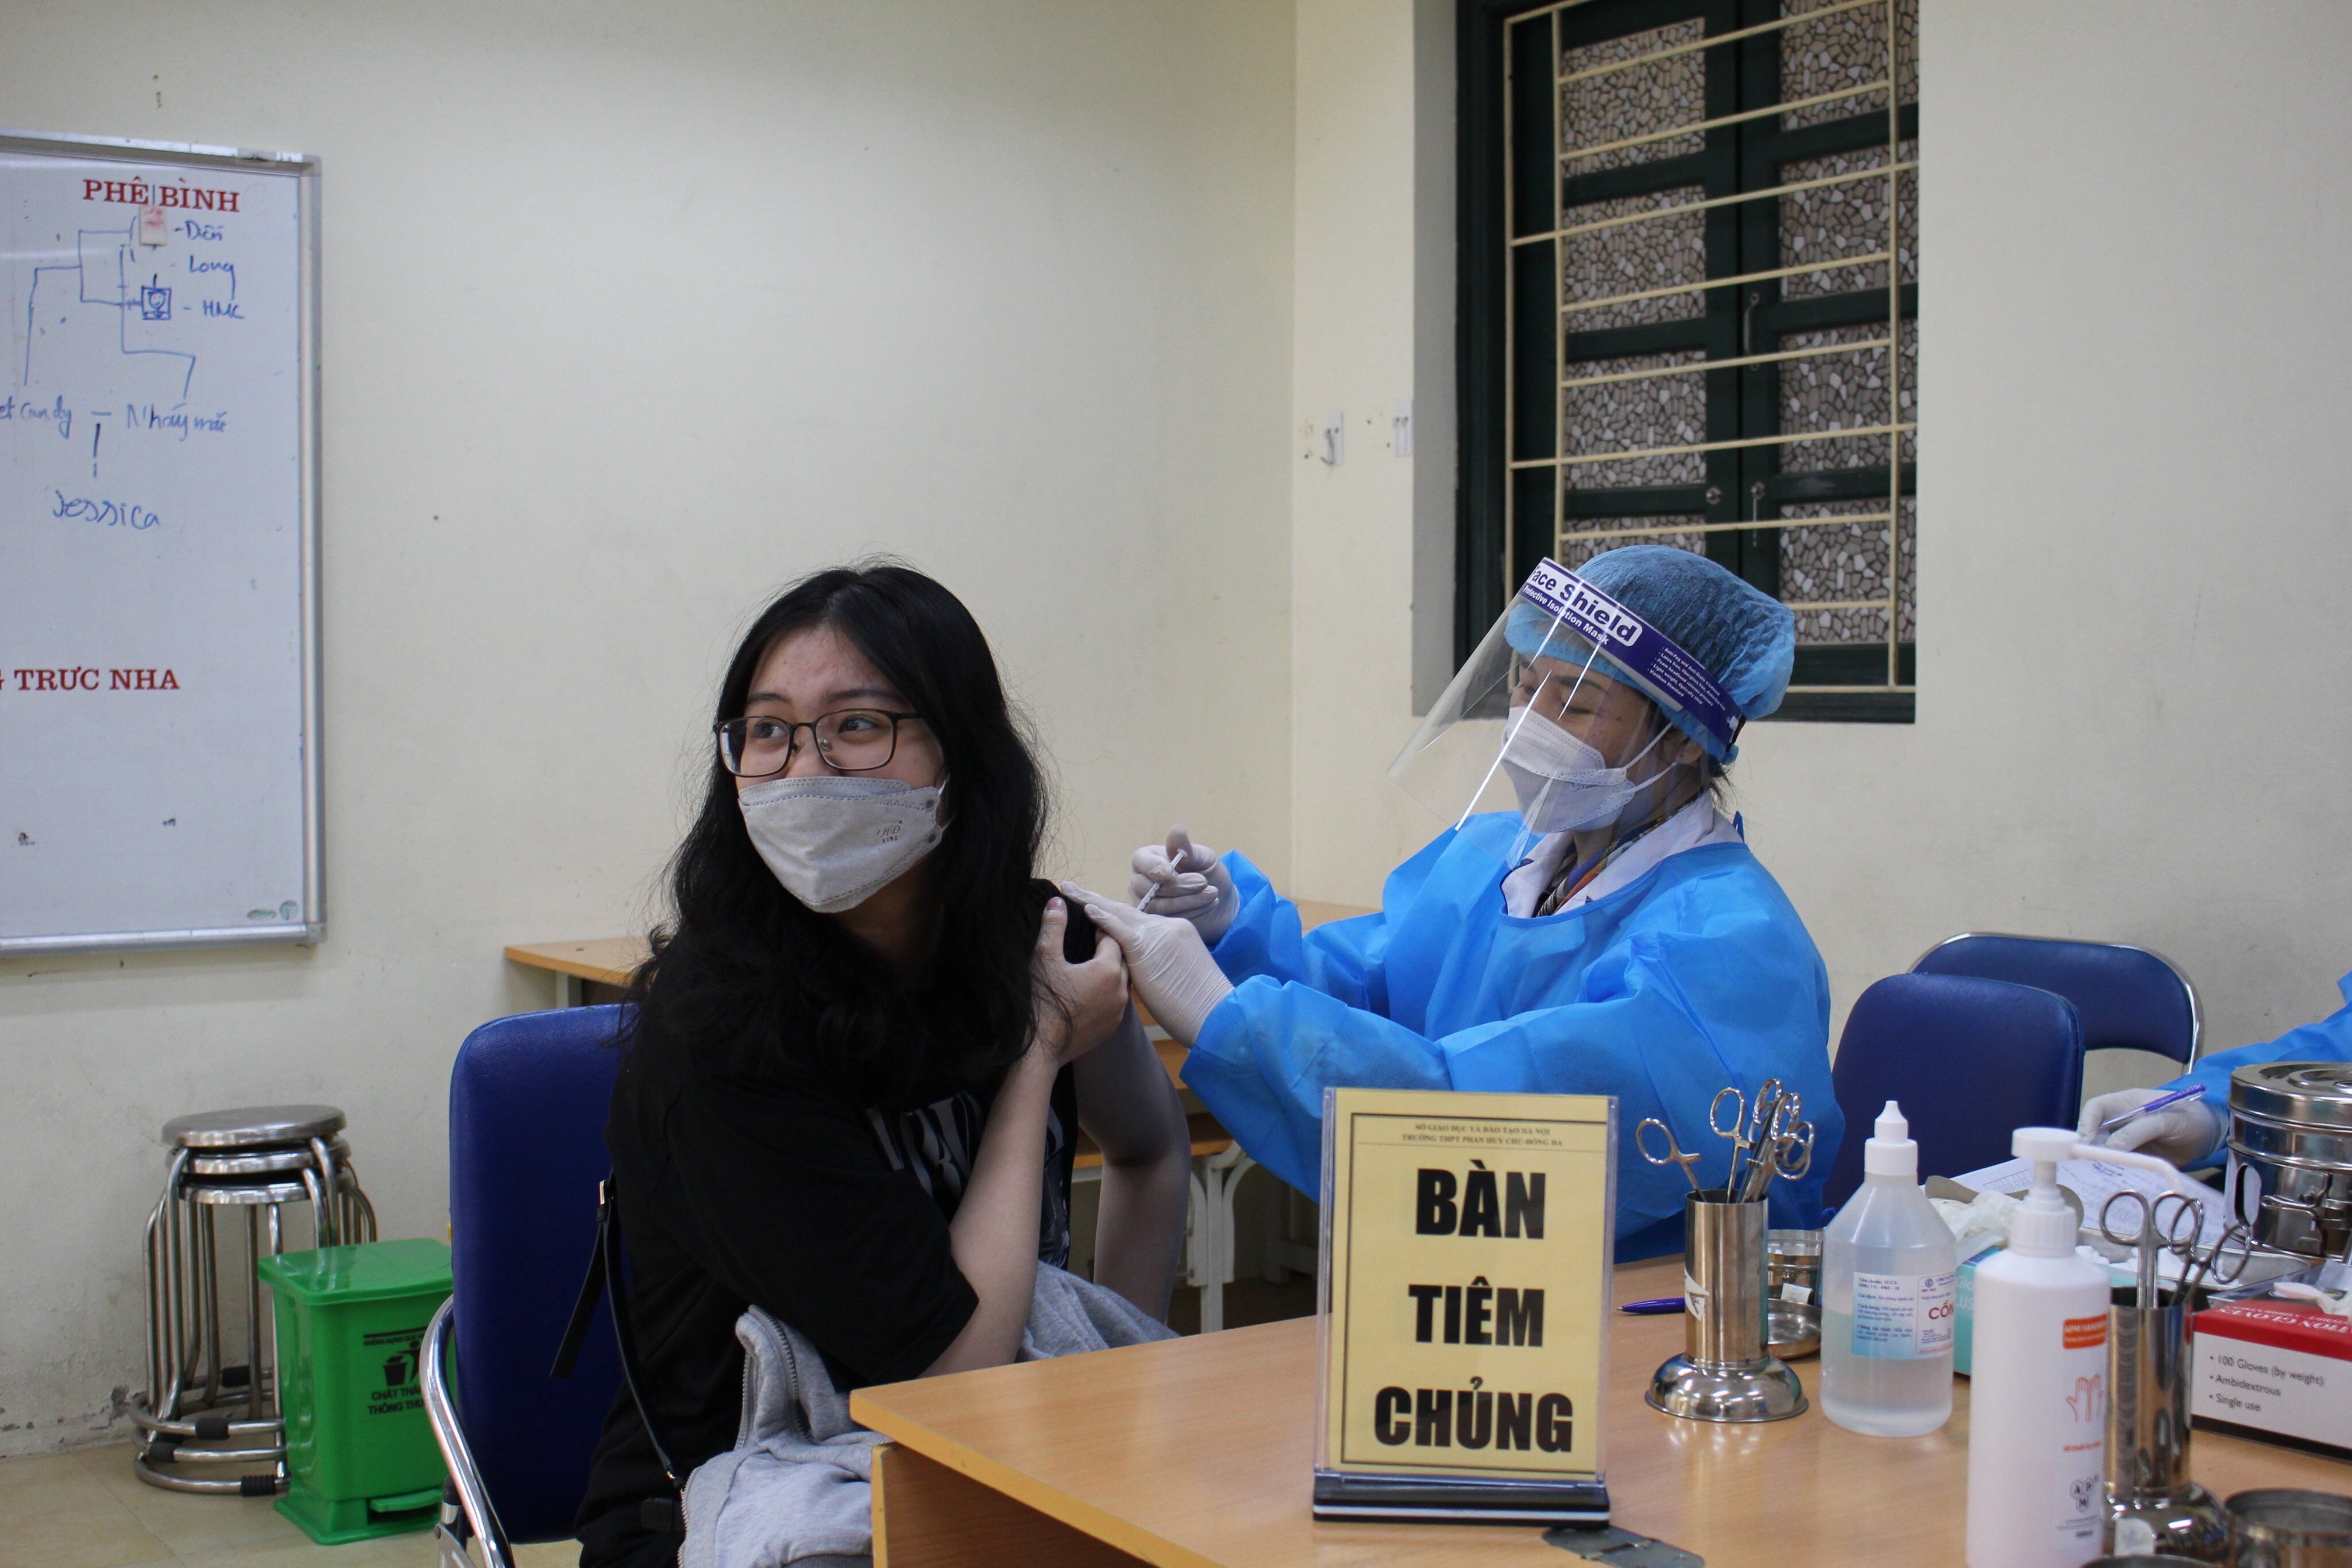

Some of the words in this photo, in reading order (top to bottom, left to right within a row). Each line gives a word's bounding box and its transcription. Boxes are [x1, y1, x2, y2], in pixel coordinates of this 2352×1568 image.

[83, 176, 149, 205] PHÊ
[159, 177, 240, 212] BÌNH
[53, 490, 161, 530] Jessica
[1559, 584, 1637, 642] Shield
[1582, 623, 1609, 645] Mask
[1653, 664, 1665, 674] Light
[1657, 658, 1669, 669] Foam
[1660, 653, 1673, 663] Latex
[1667, 682, 1684, 697] Standard
[1415, 1159, 1546, 1239] BÀN
[1408, 1276, 1545, 1347] TIÊM
[2218, 1354, 2234, 1366] 100
[2237, 1358, 2268, 1374] Gloves
[2271, 1365, 2287, 1380] (by
[2289, 1372, 2325, 1387] weight)
[2215, 1374, 2281, 1396] Ambidextrous
[1374, 1376, 1573, 1453] CHỦNG
[2216, 1393, 2242, 1409] Single
[2245, 1401, 2261, 1412] use
